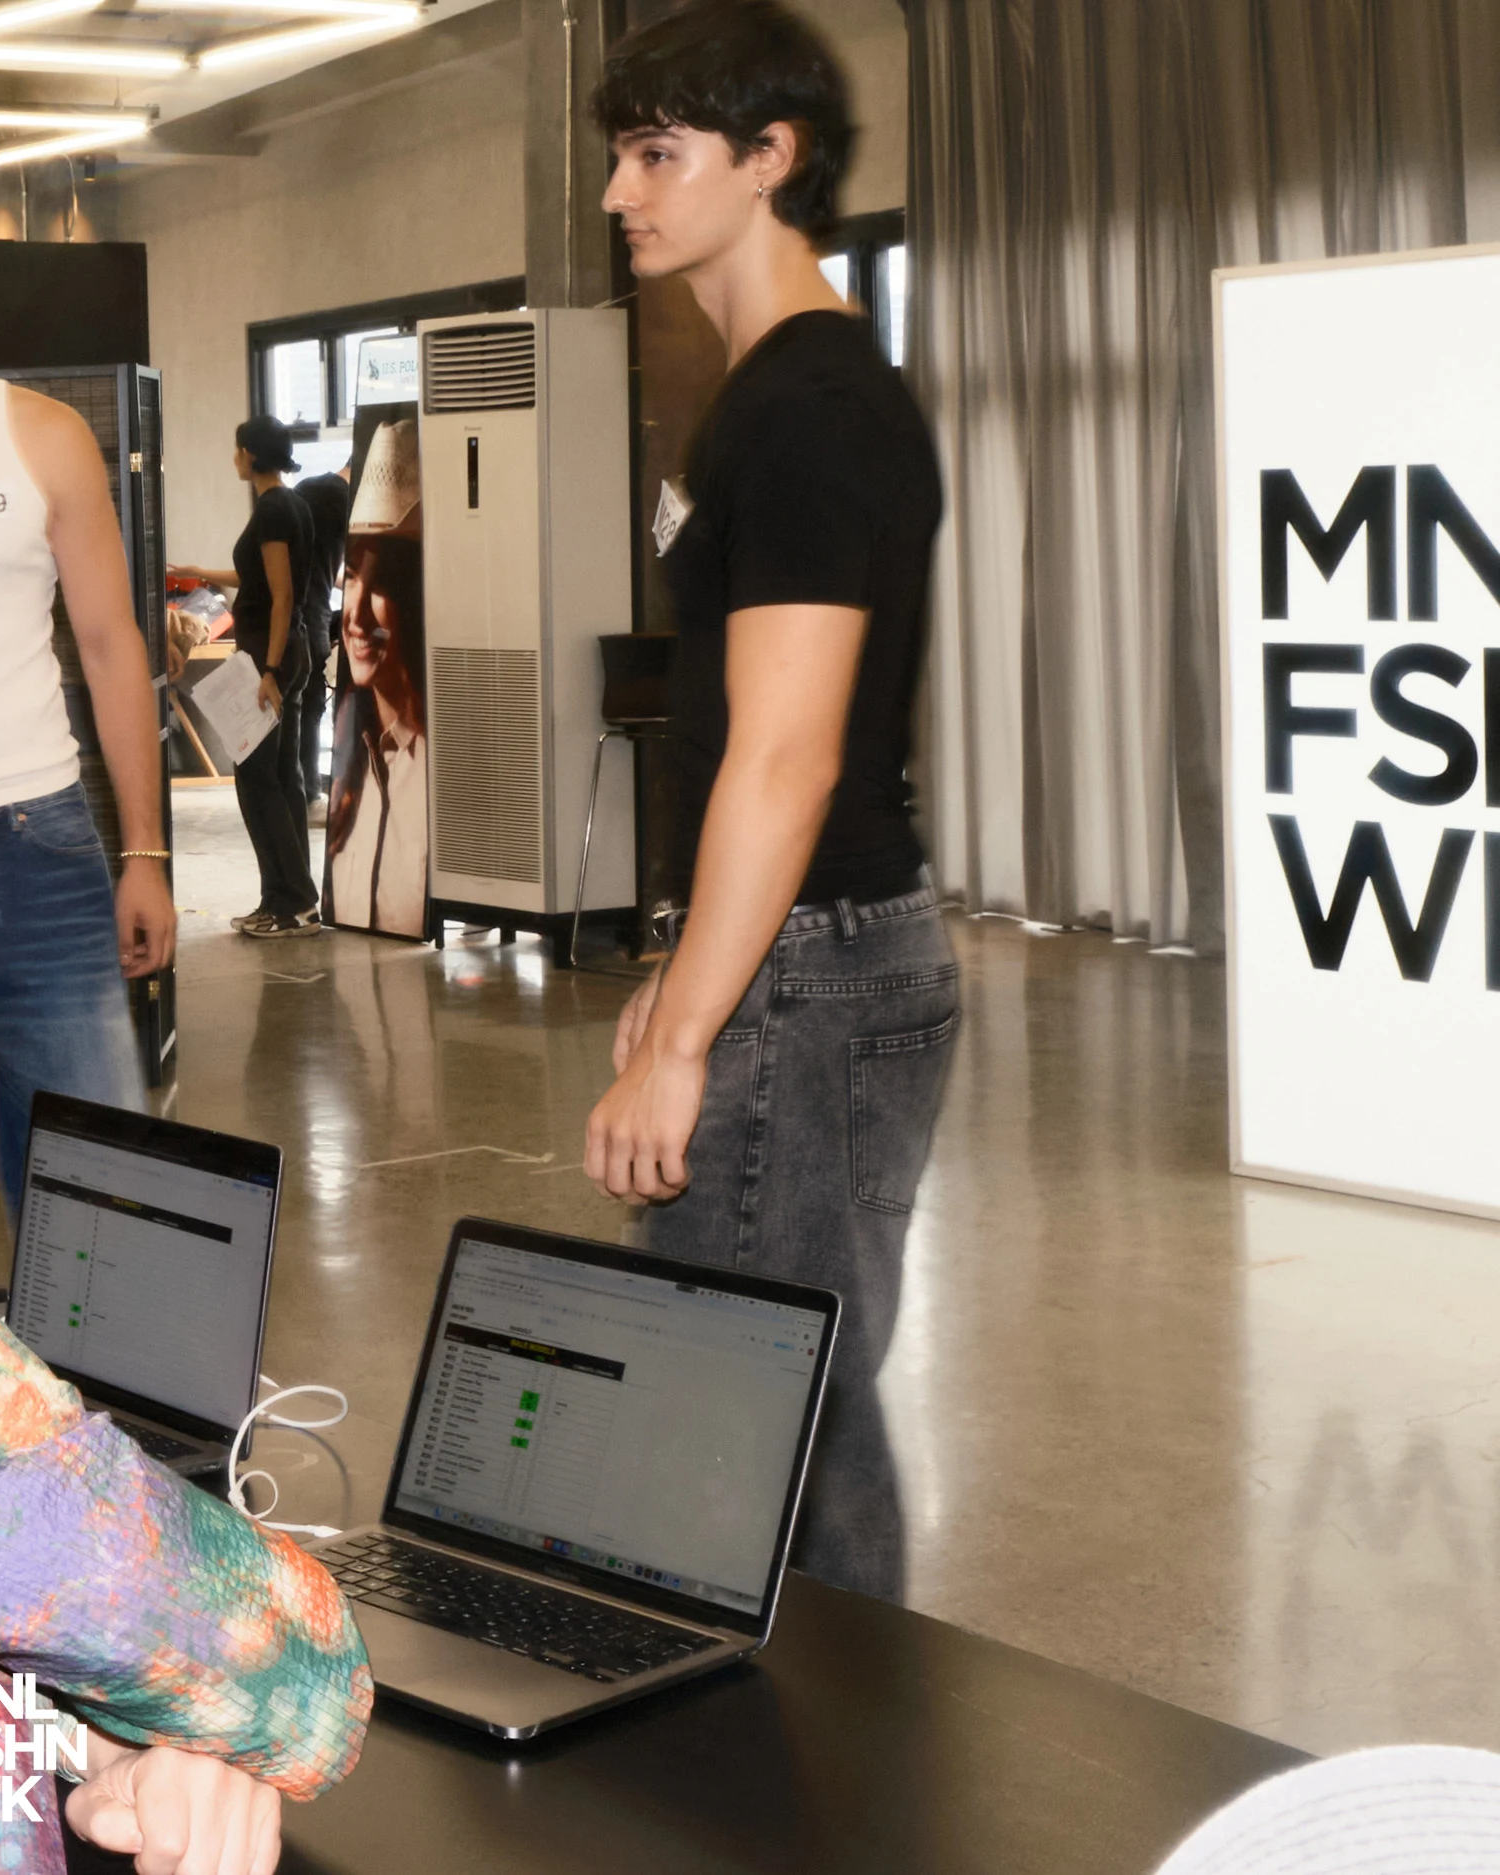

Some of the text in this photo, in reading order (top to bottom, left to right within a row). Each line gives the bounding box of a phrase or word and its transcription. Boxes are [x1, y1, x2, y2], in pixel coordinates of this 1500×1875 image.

[399, 360, 418, 373] POL
[1262, 643, 1500, 808] FS
[1266, 813, 1500, 992] W
